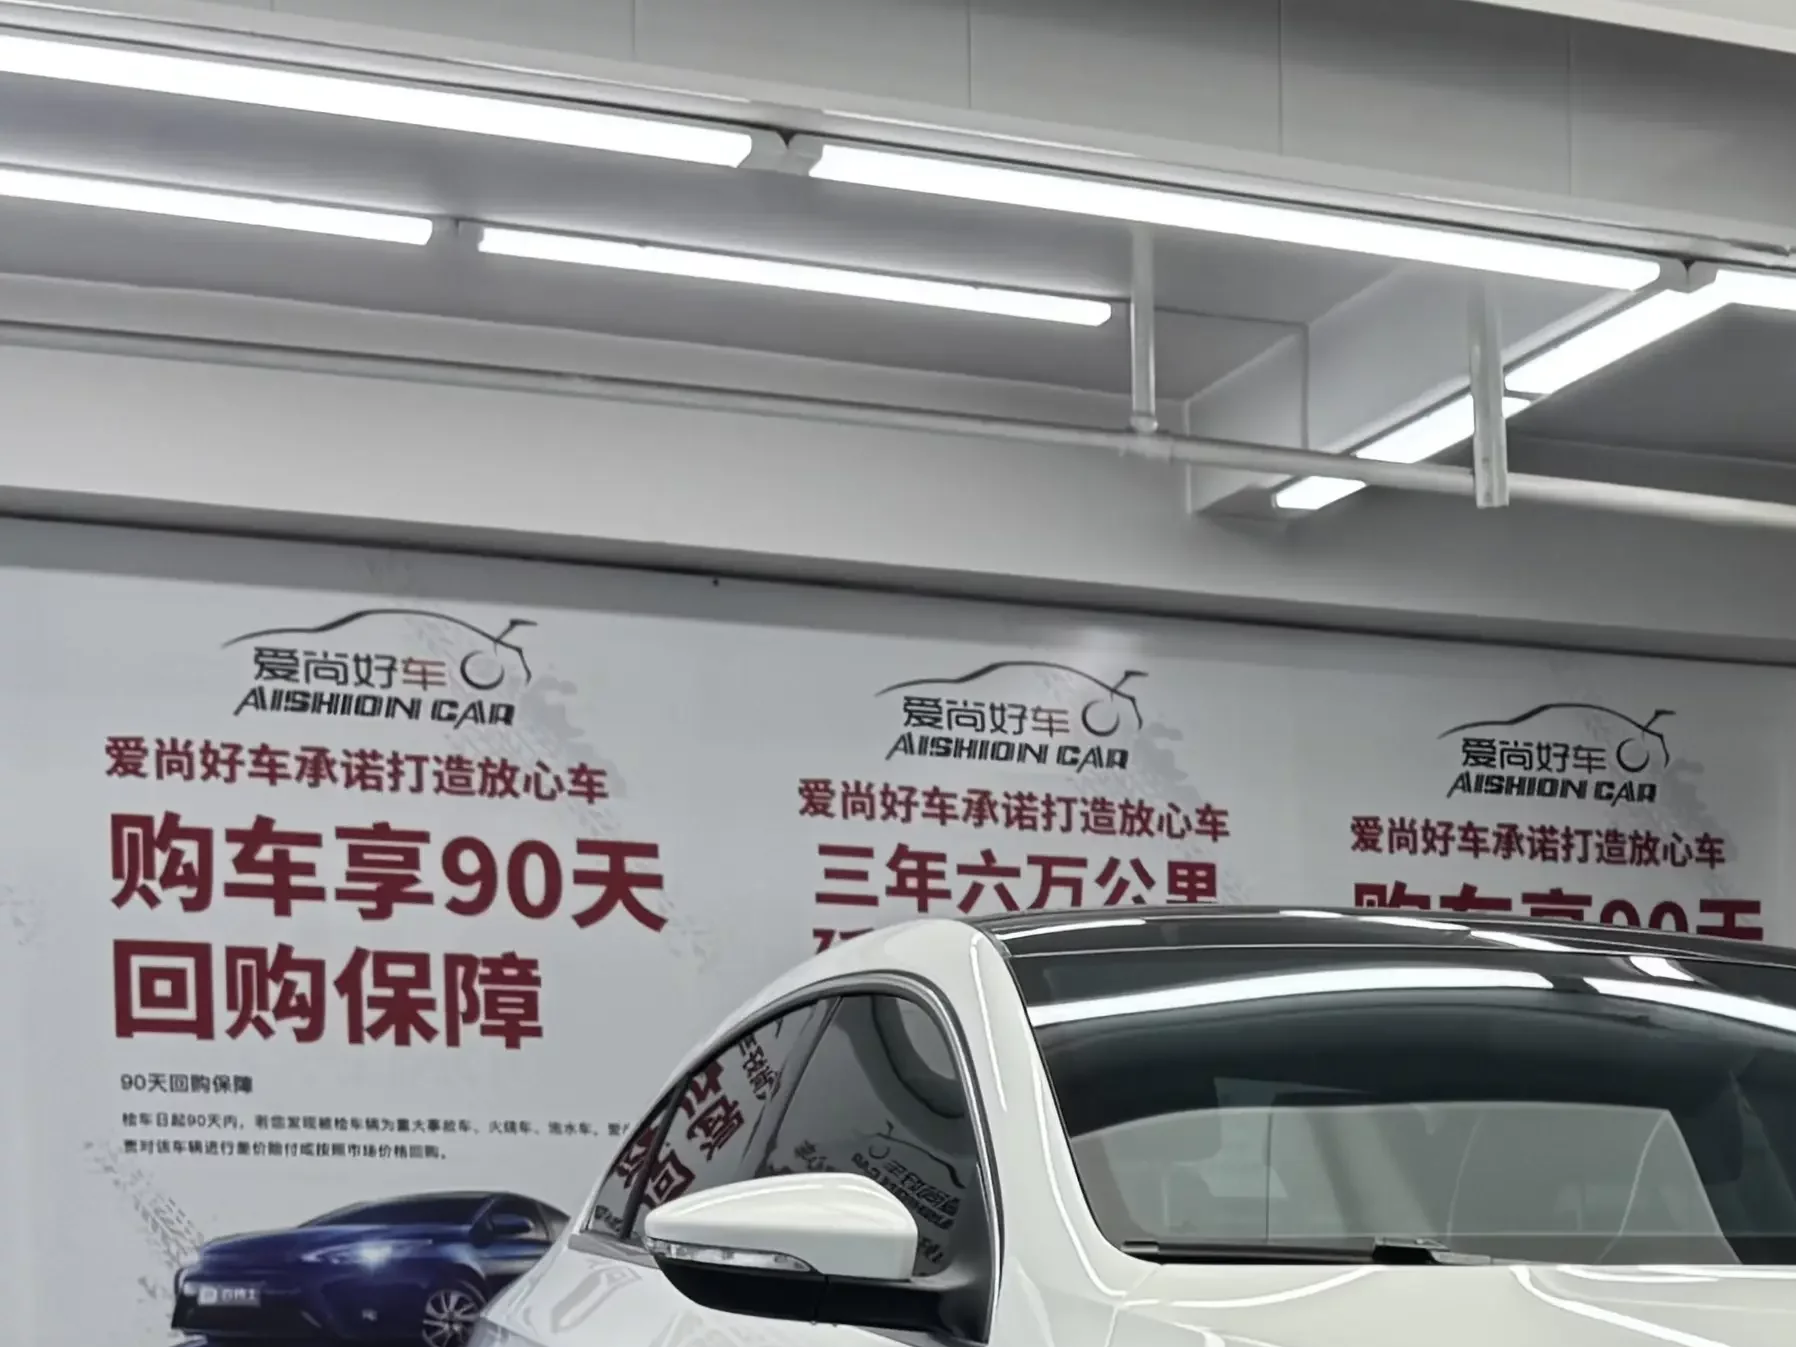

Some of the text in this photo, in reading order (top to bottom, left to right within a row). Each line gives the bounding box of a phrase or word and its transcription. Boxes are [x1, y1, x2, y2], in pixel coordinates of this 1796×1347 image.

[253, 646, 447, 691] 爱尚好车
[233, 685, 516, 729] AISHION CAR
[902, 695, 1070, 737] 爱尚好车
[104, 735, 609, 805] 爱尚好车承诺打造放心车
[885, 731, 1129, 773] AISHION CAR
[1462, 738, 1607, 774] 爱尚好车
[797, 778, 1230, 843] 爱尚好车承诺打造放心车
[1446, 770, 1657, 807] AISHION CAR
[1350, 815, 1726, 869] 爱尚好车承诺打造放心车
[109, 811, 668, 932] 购车享90天
[815, 843, 1218, 914] 三年六万公里
[112, 938, 544, 1050] 回购保障
[120, 1073, 253, 1095] 90天回购保障
